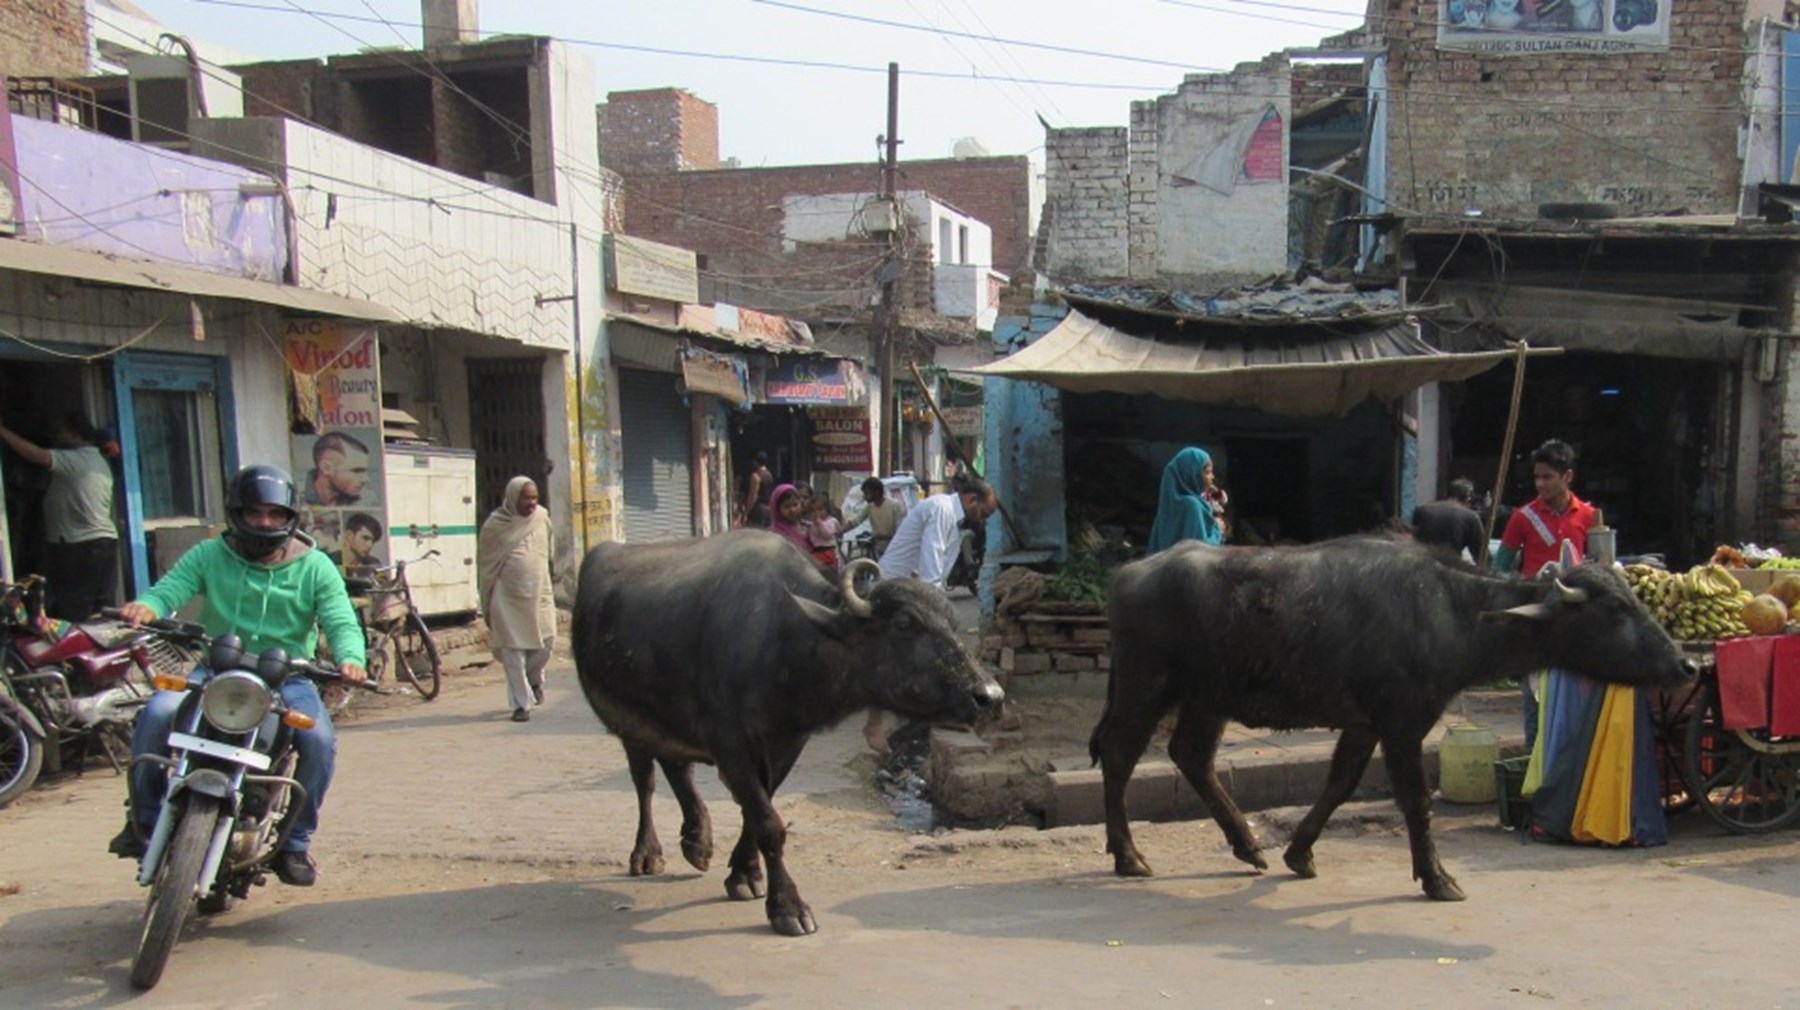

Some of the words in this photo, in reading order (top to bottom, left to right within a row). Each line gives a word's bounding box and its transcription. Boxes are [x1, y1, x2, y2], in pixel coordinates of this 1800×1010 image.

[1515, 39, 1561, 51] SULTAN
[288, 340, 373, 372] Vinod
[329, 376, 378, 402] Beauty
[321, 404, 373, 425] alon
[815, 420, 863, 431] SALON
